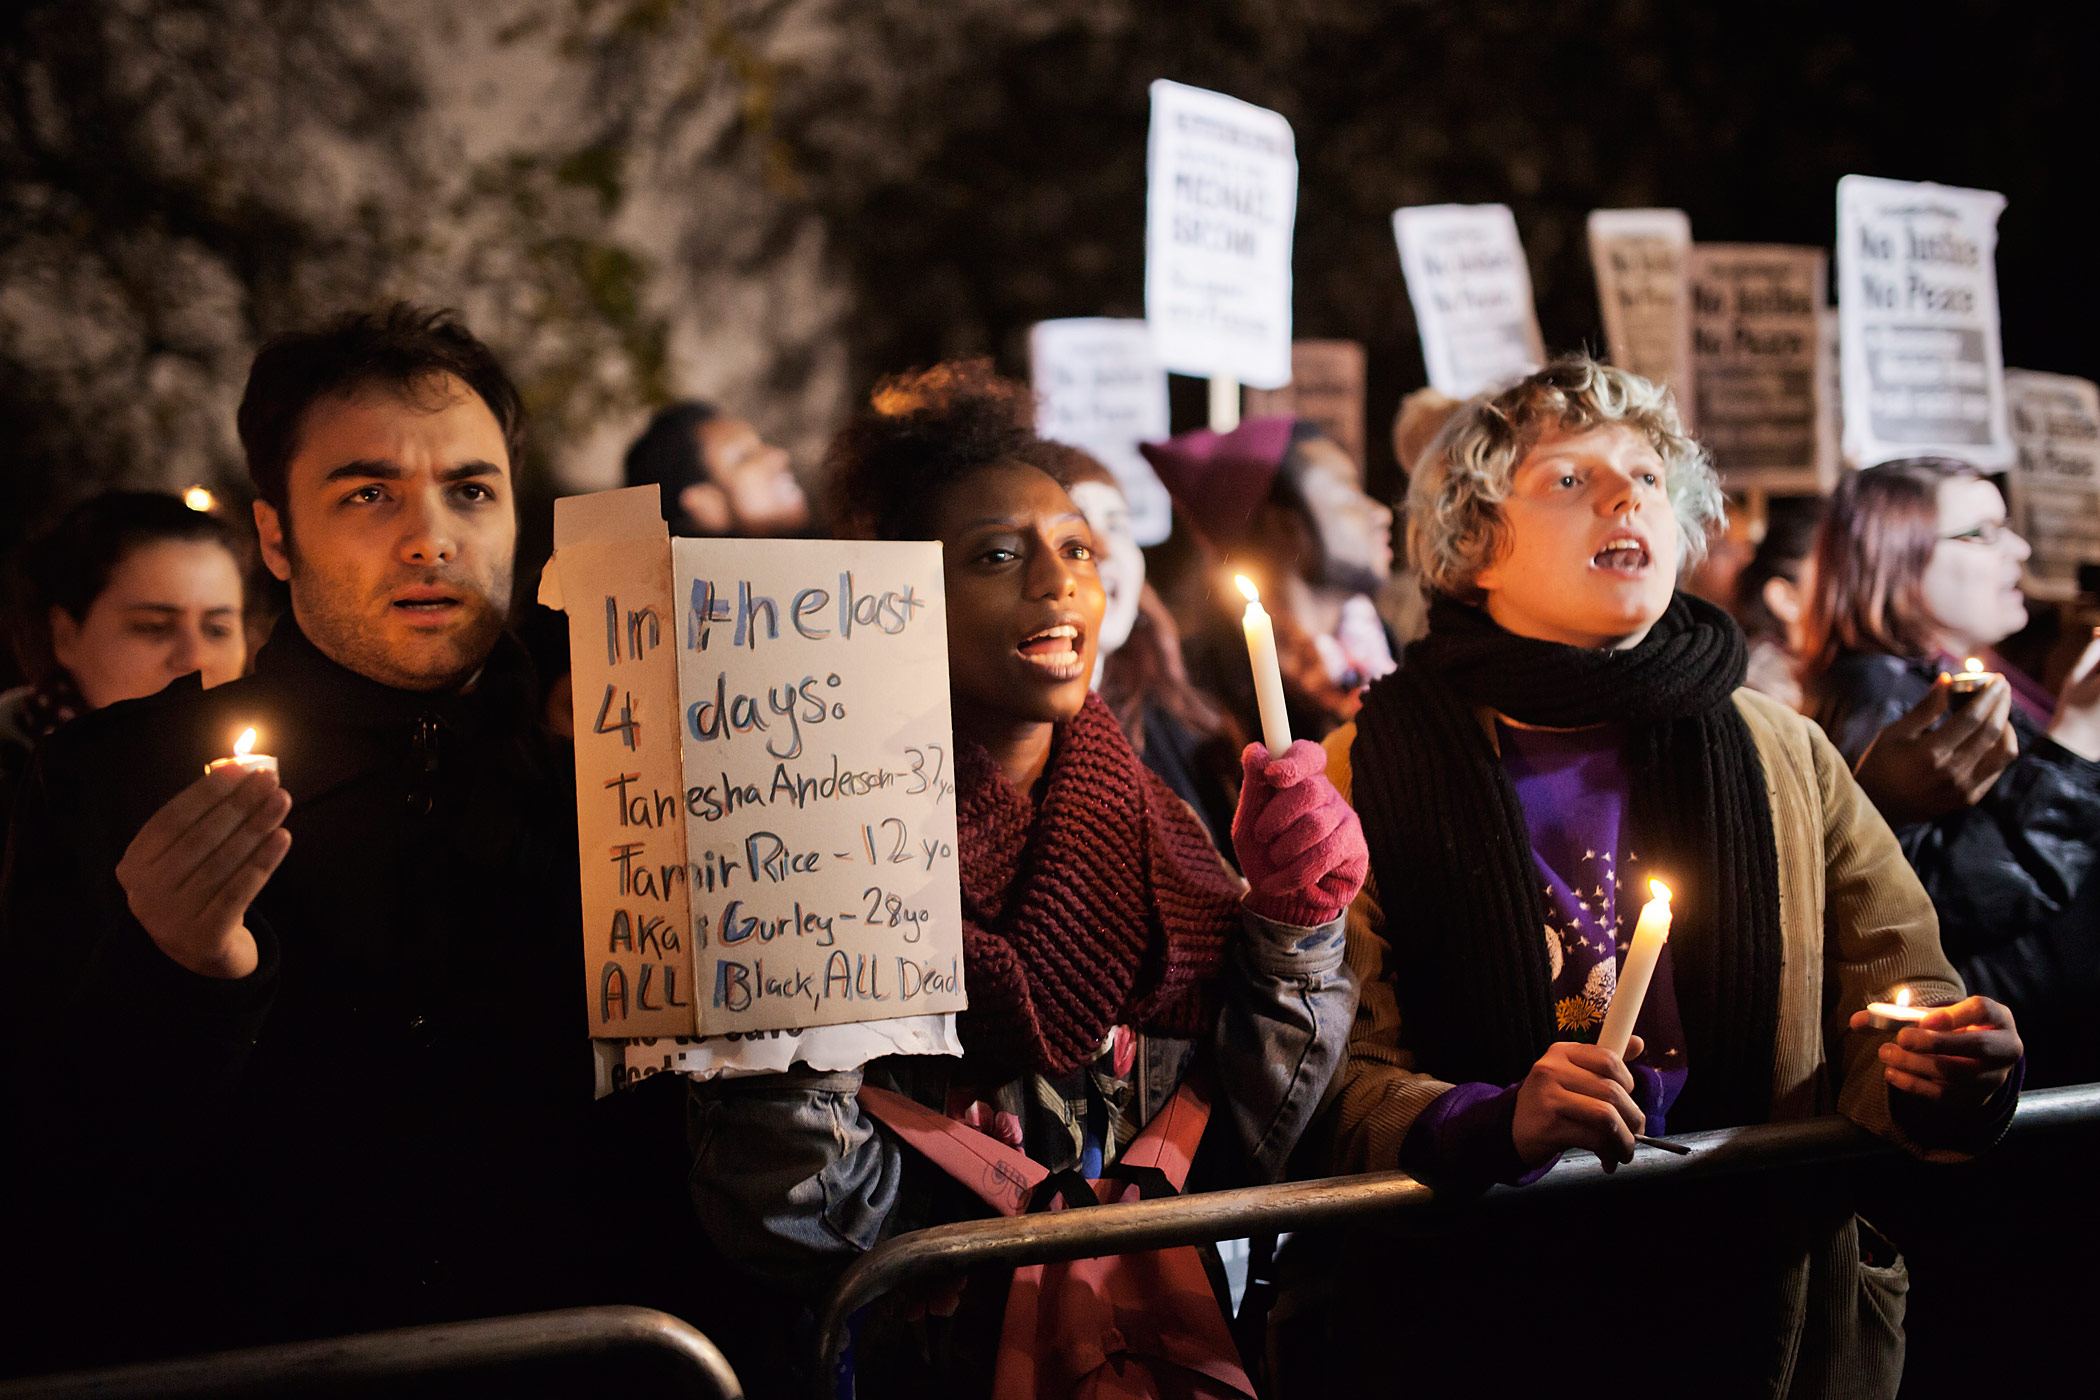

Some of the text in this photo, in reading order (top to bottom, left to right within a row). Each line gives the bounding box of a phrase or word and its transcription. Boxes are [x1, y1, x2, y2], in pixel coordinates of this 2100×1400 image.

[1859, 222, 1980, 267] No Justice
[1861, 271, 1976, 313] No Peace
[605, 570, 926, 666] In the last
[593, 672, 847, 760] 4 days:
[605, 772, 766, 828] Tanesha
[745, 830, 822, 884] Rice
[861, 818, 915, 867] 12
[921, 838, 952, 872] yo
[601, 960, 689, 1024] ALL
[895, 953, 961, 1001] Dead
